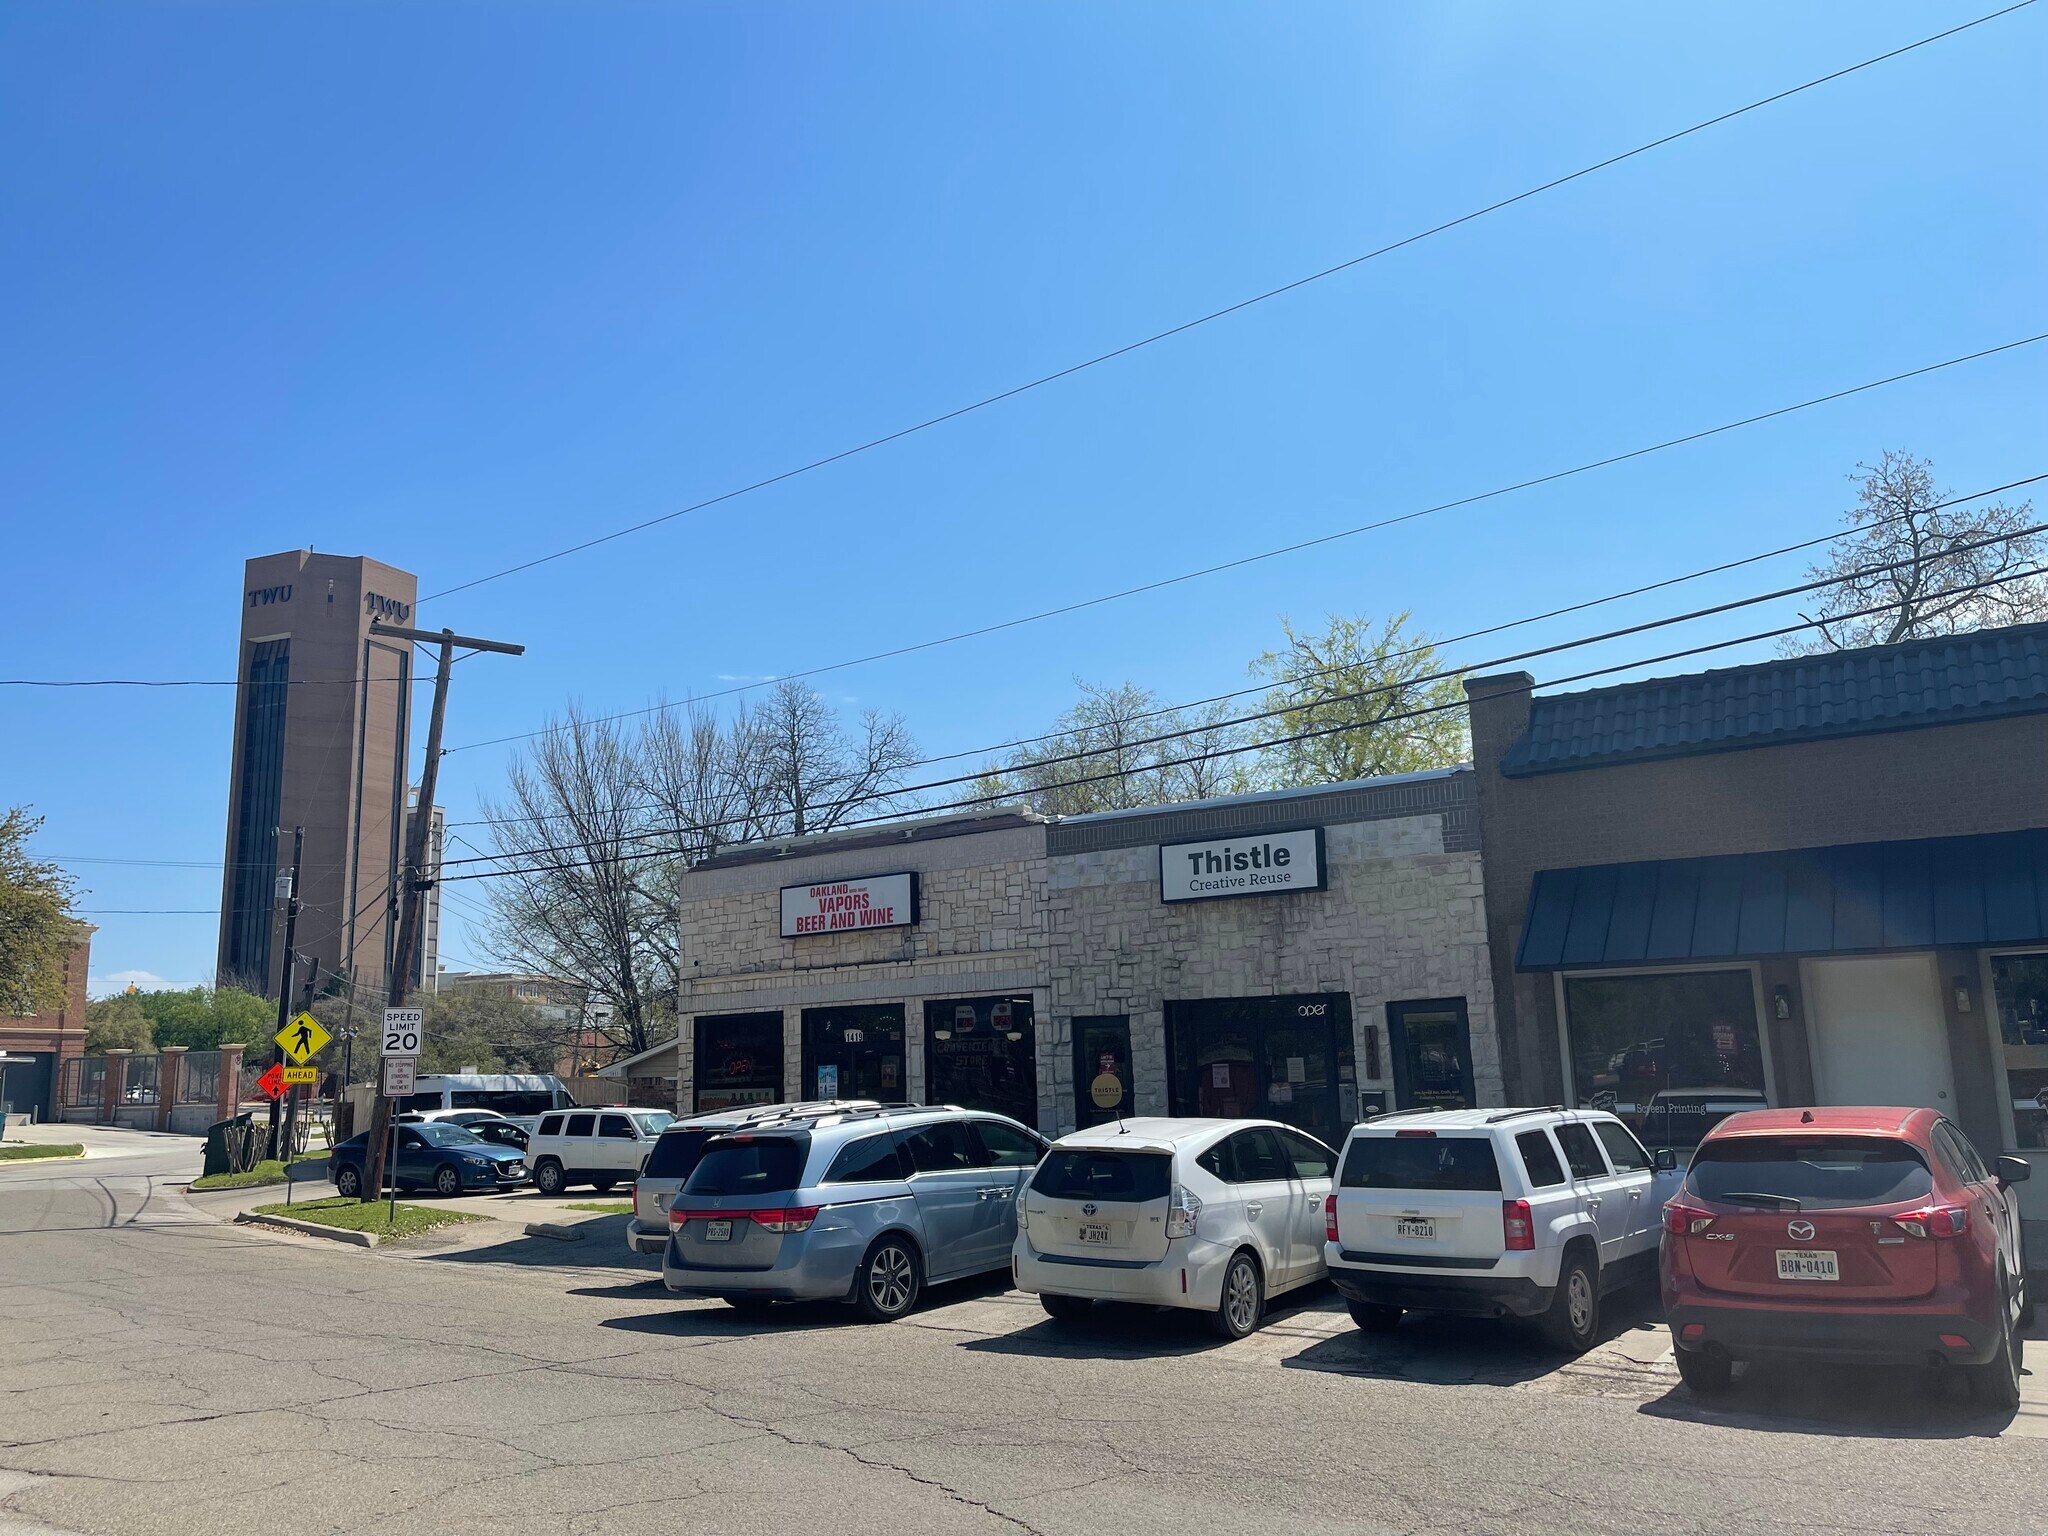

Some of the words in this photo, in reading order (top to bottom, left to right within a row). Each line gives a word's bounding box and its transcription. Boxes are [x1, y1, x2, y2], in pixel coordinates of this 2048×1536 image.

[248, 584, 293, 608] TWU
[367, 591, 410, 621] TWU
[1188, 843, 1291, 876] Thistle
[1189, 875, 1245, 892] Creative
[1248, 872, 1291, 887] Reuse
[810, 883, 849, 898] OAKLAND
[818, 893, 870, 914] VAPORS
[796, 914, 826, 933] BEER
[829, 911, 856, 930] AND
[859, 907, 894, 926] WINE
[386, 1013, 421, 1021] SPEED
[389, 1023, 416, 1031] LIMIT
[385, 1033, 418, 1051] 20
[846, 1032, 863, 1042] 1419
[729, 1057, 752, 1075] OPEN
[955, 1054, 990, 1066] STORE
[287, 1071, 313, 1079] AHEAD
[1636, 1103, 1666, 1114] Screen
[1668, 1103, 1706, 1116] Printing
[1706, 1233, 1735, 1241] CX-5
